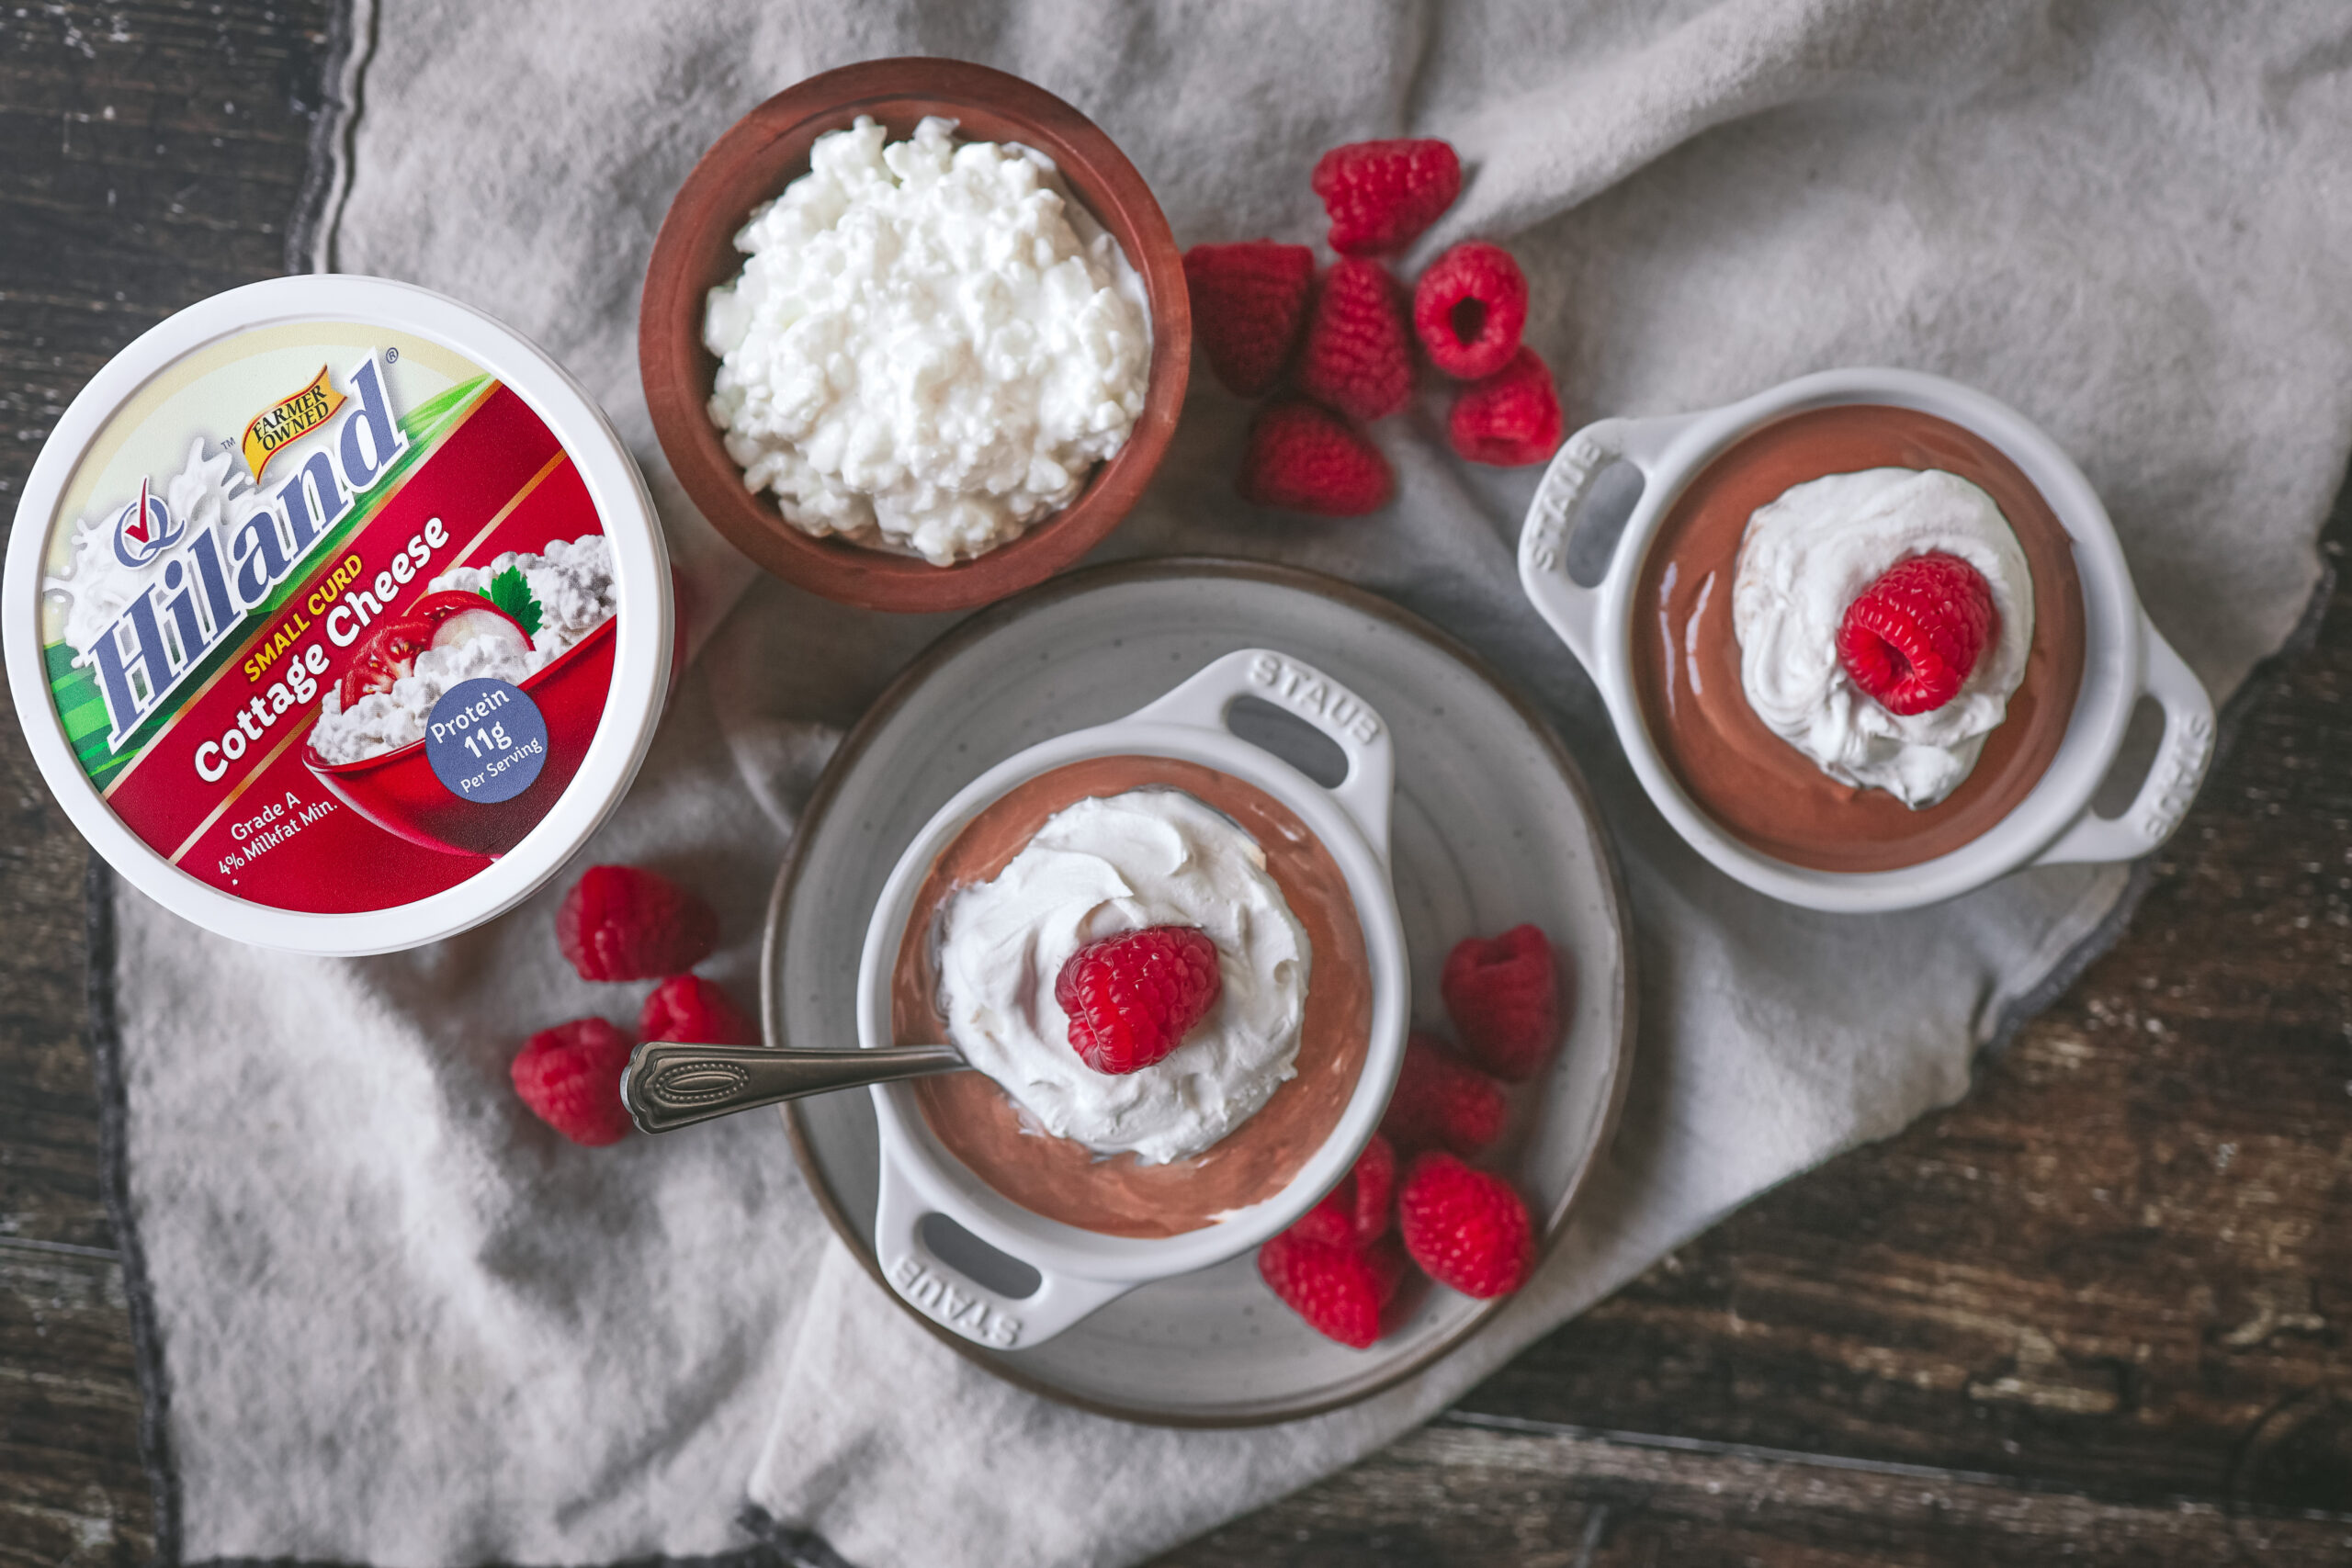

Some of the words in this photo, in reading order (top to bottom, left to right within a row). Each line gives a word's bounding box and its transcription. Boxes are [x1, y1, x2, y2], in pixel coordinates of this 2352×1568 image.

[253, 385, 326, 443] FARMER
[263, 401, 329, 451] OWNED
[90, 358, 402, 743] Hiland
[195, 644, 330, 782] Cottage
[326, 517, 449, 647] Cheese
[244, 611, 311, 682] SMALL
[308, 555, 362, 615] CURD
[430, 690, 510, 744] Protein
[1249, 653, 1381, 745] STAUB
[460, 773, 485, 794] Per
[486, 738, 543, 777] Serving
[464, 721, 512, 759] 11g
[219, 852, 245, 874] 4%
[242, 818, 301, 862] Milkfat
[299, 801, 337, 827] Min.
[231, 804, 285, 840] Grade
[285, 791, 301, 809] A
[890, 1257, 1023, 1346] STAUB
